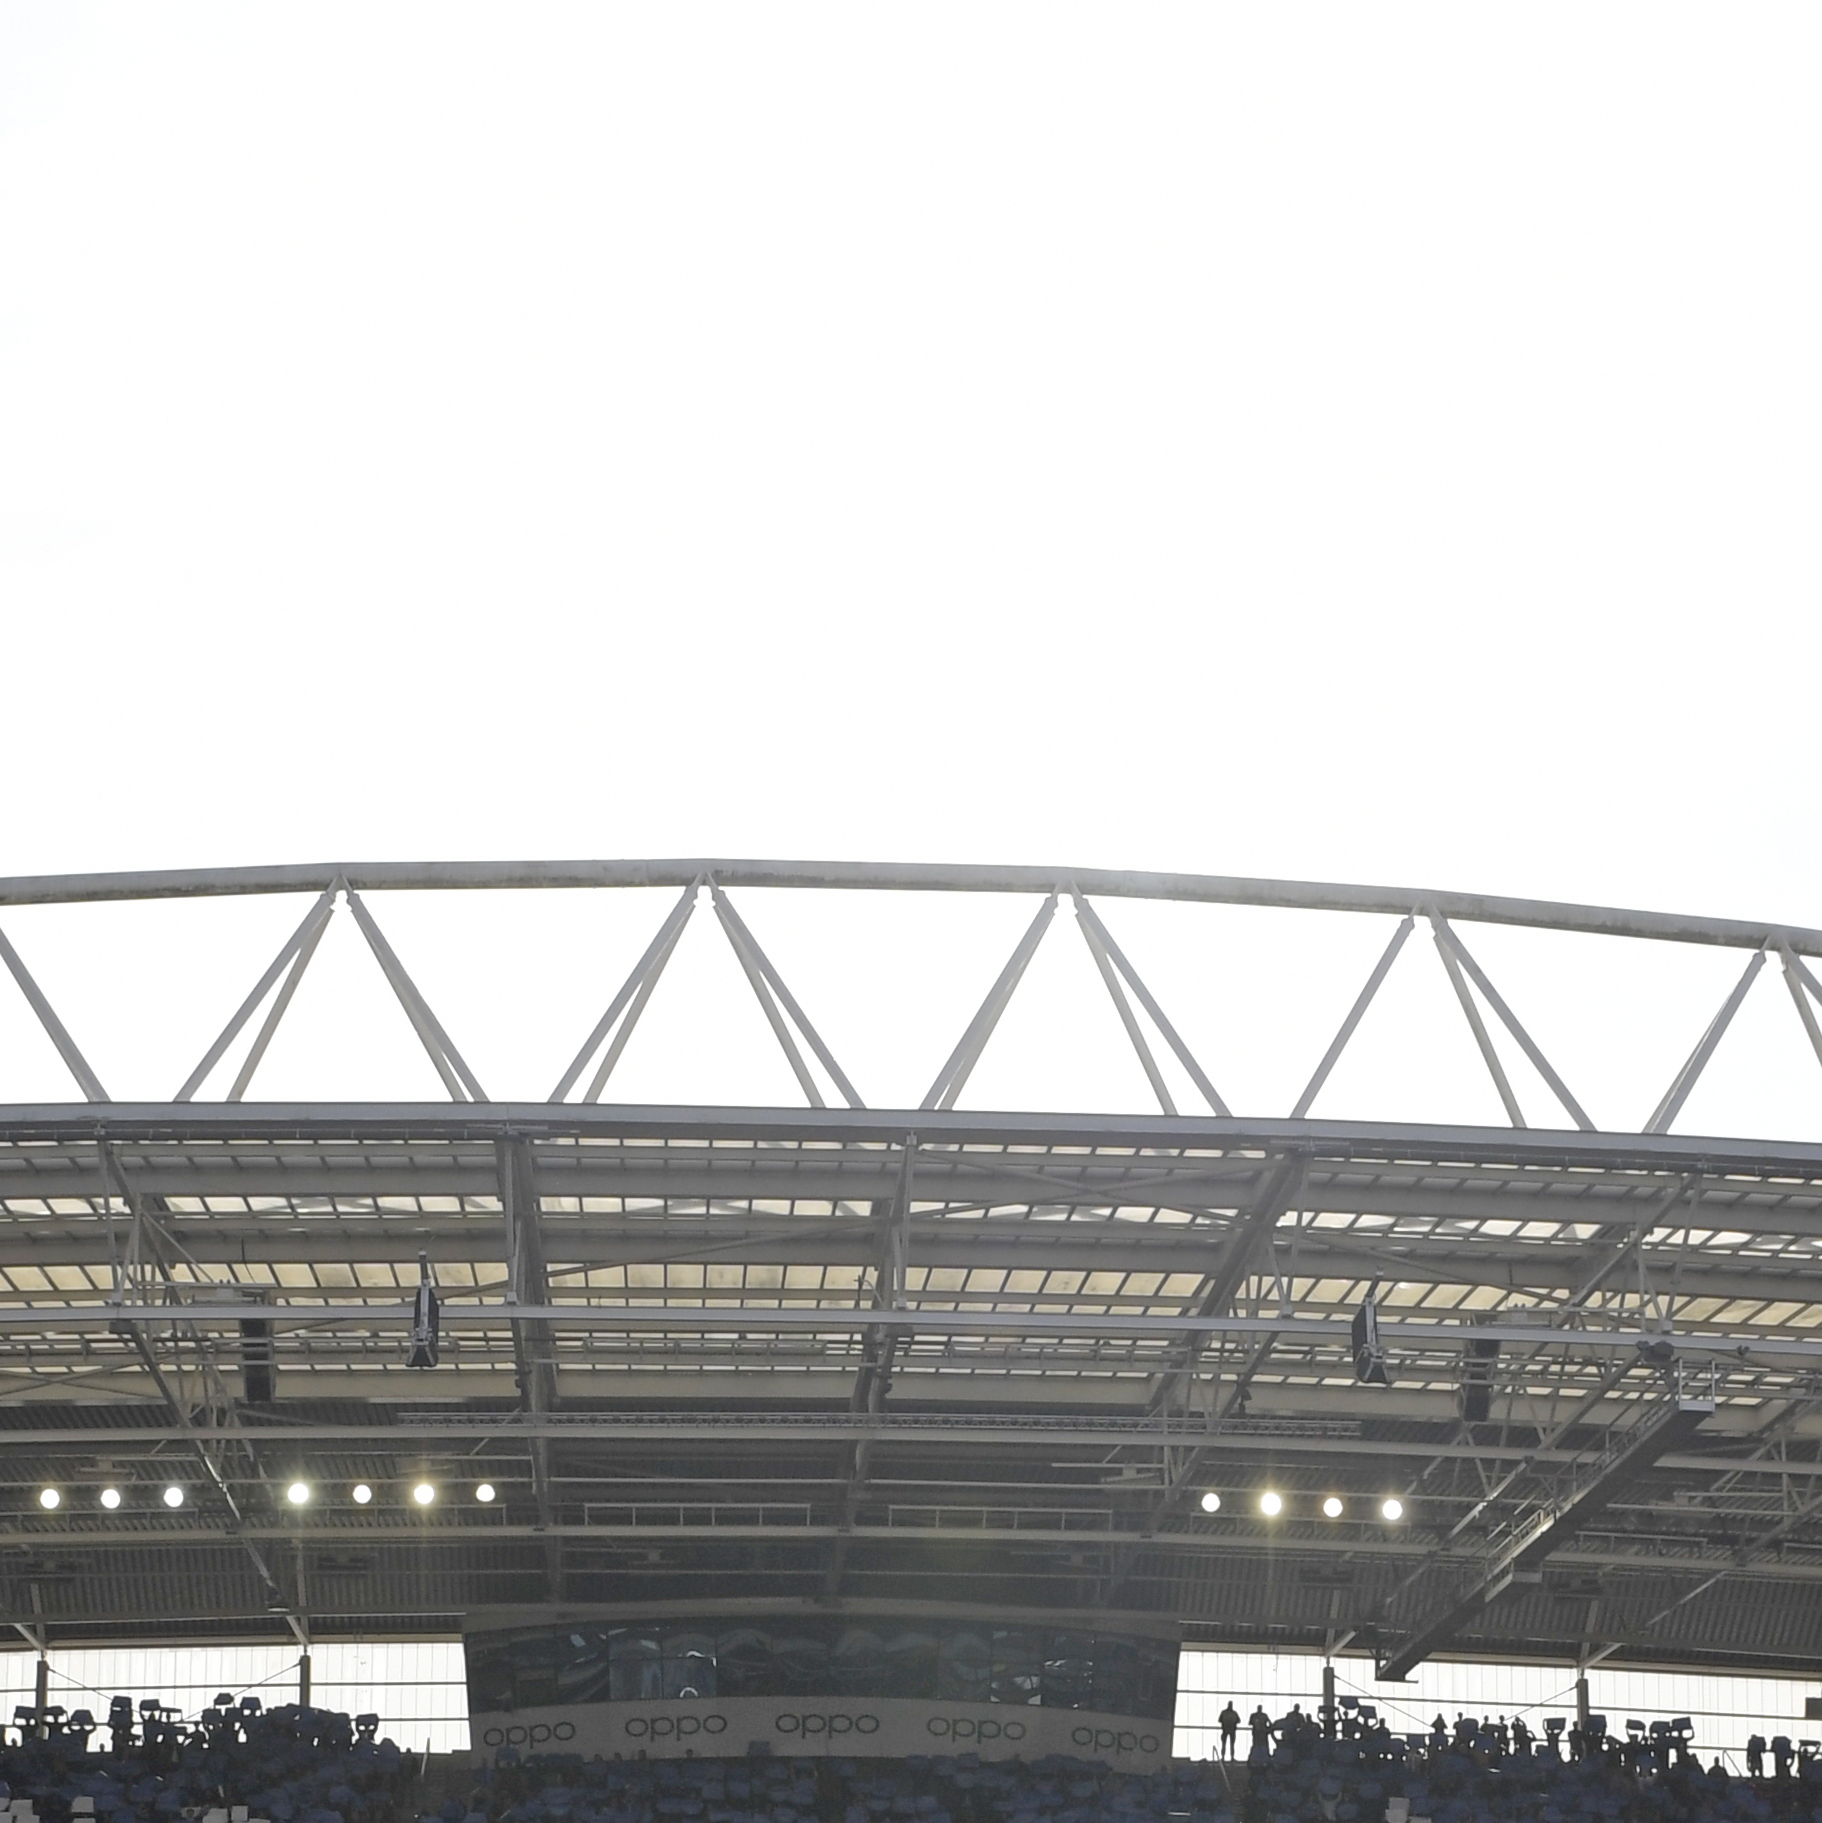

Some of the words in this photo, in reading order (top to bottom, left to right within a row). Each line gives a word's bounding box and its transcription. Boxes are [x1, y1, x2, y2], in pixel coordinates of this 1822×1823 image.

[483, 1721, 576, 1749] oppo
[626, 1715, 727, 1742] oppo
[775, 1713, 880, 1739] oppo
[926, 1716, 1026, 1744] oppo
[1071, 1726, 1159, 1753] oppo
